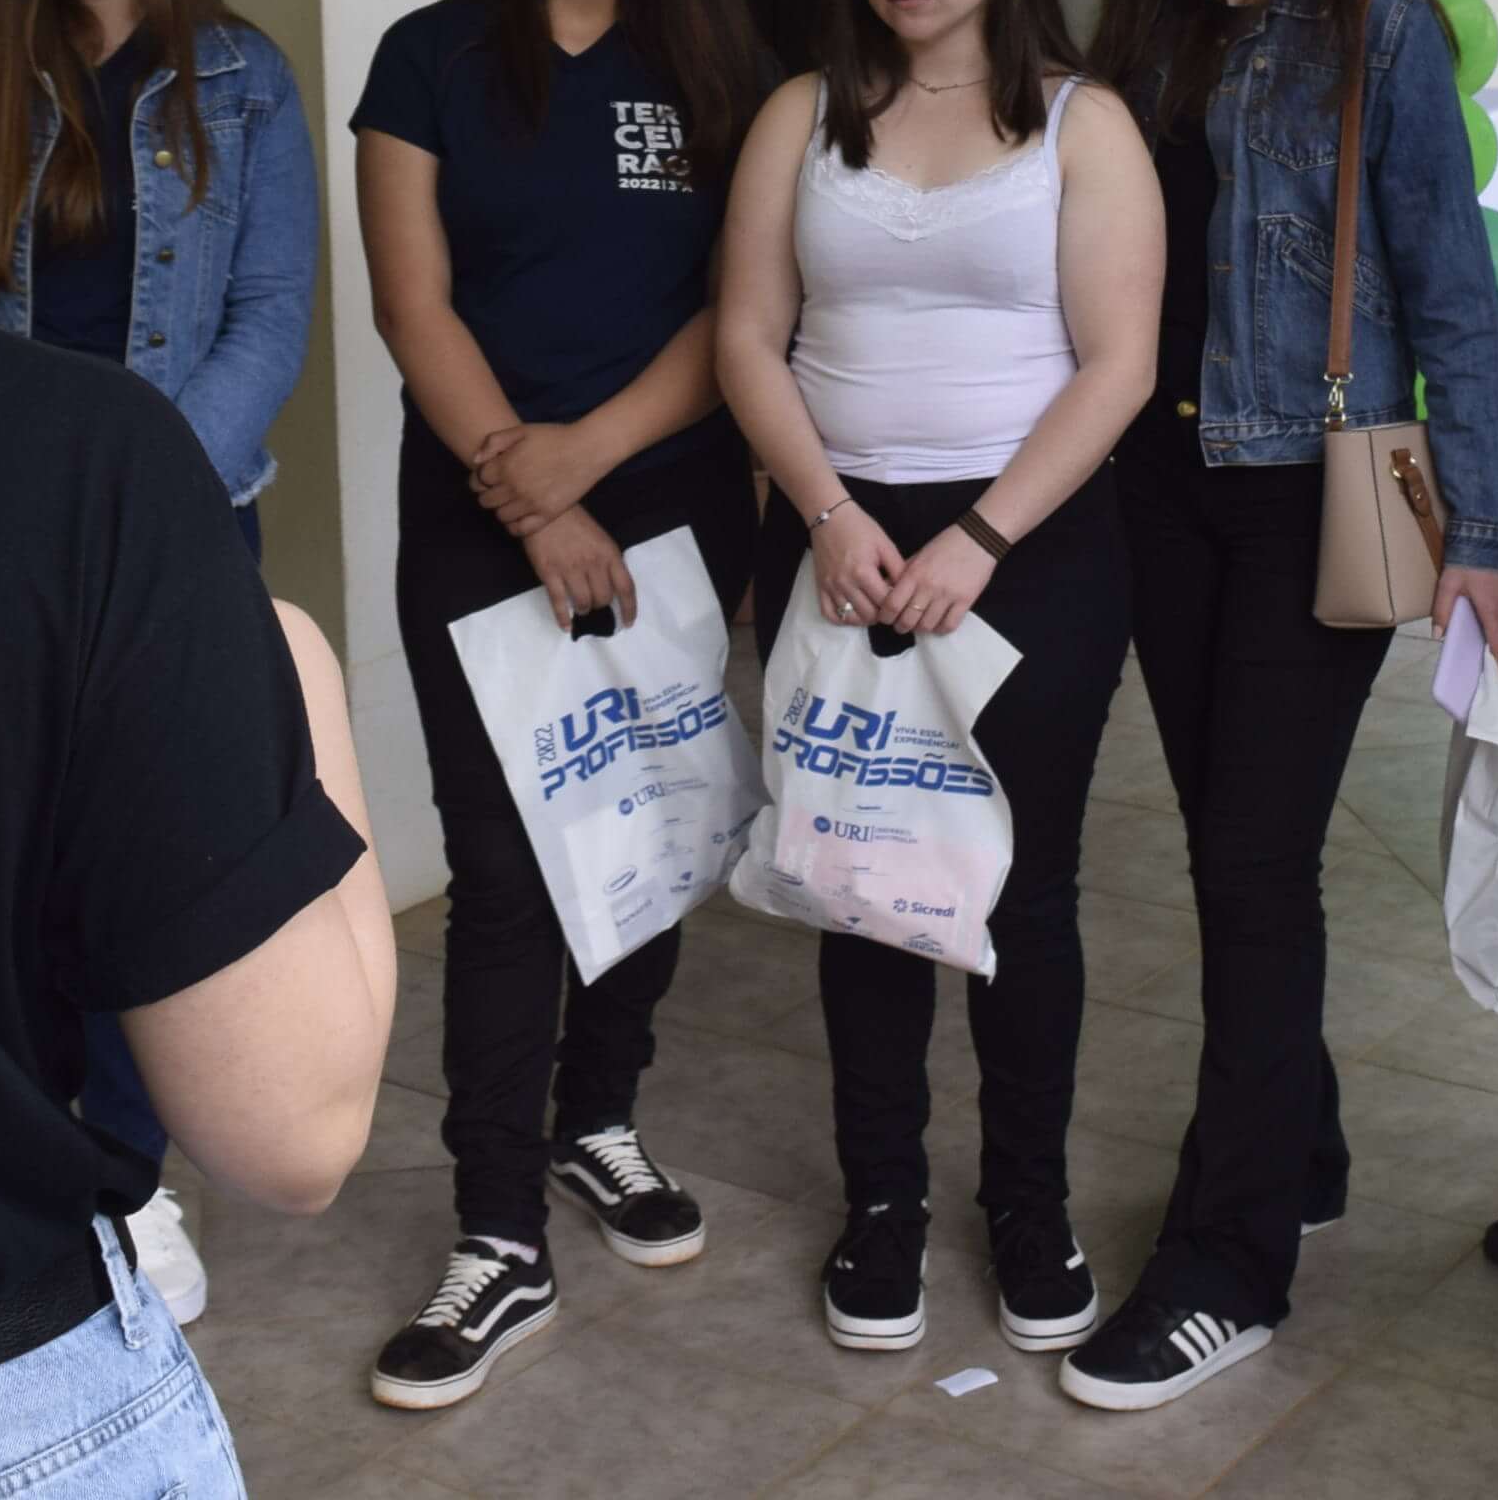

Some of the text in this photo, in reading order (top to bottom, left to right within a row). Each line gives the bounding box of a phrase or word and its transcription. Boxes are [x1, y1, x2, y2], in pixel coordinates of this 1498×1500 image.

[609, 100, 682, 126] TER
[613, 123, 684, 150] CEI
[559, 686, 642, 753] URI
[803, 695, 898, 752] URI
[540, 690, 728, 801] PROFISSÕE
[832, 820, 871, 842] URI
[910, 902, 957, 919] Sicredi
